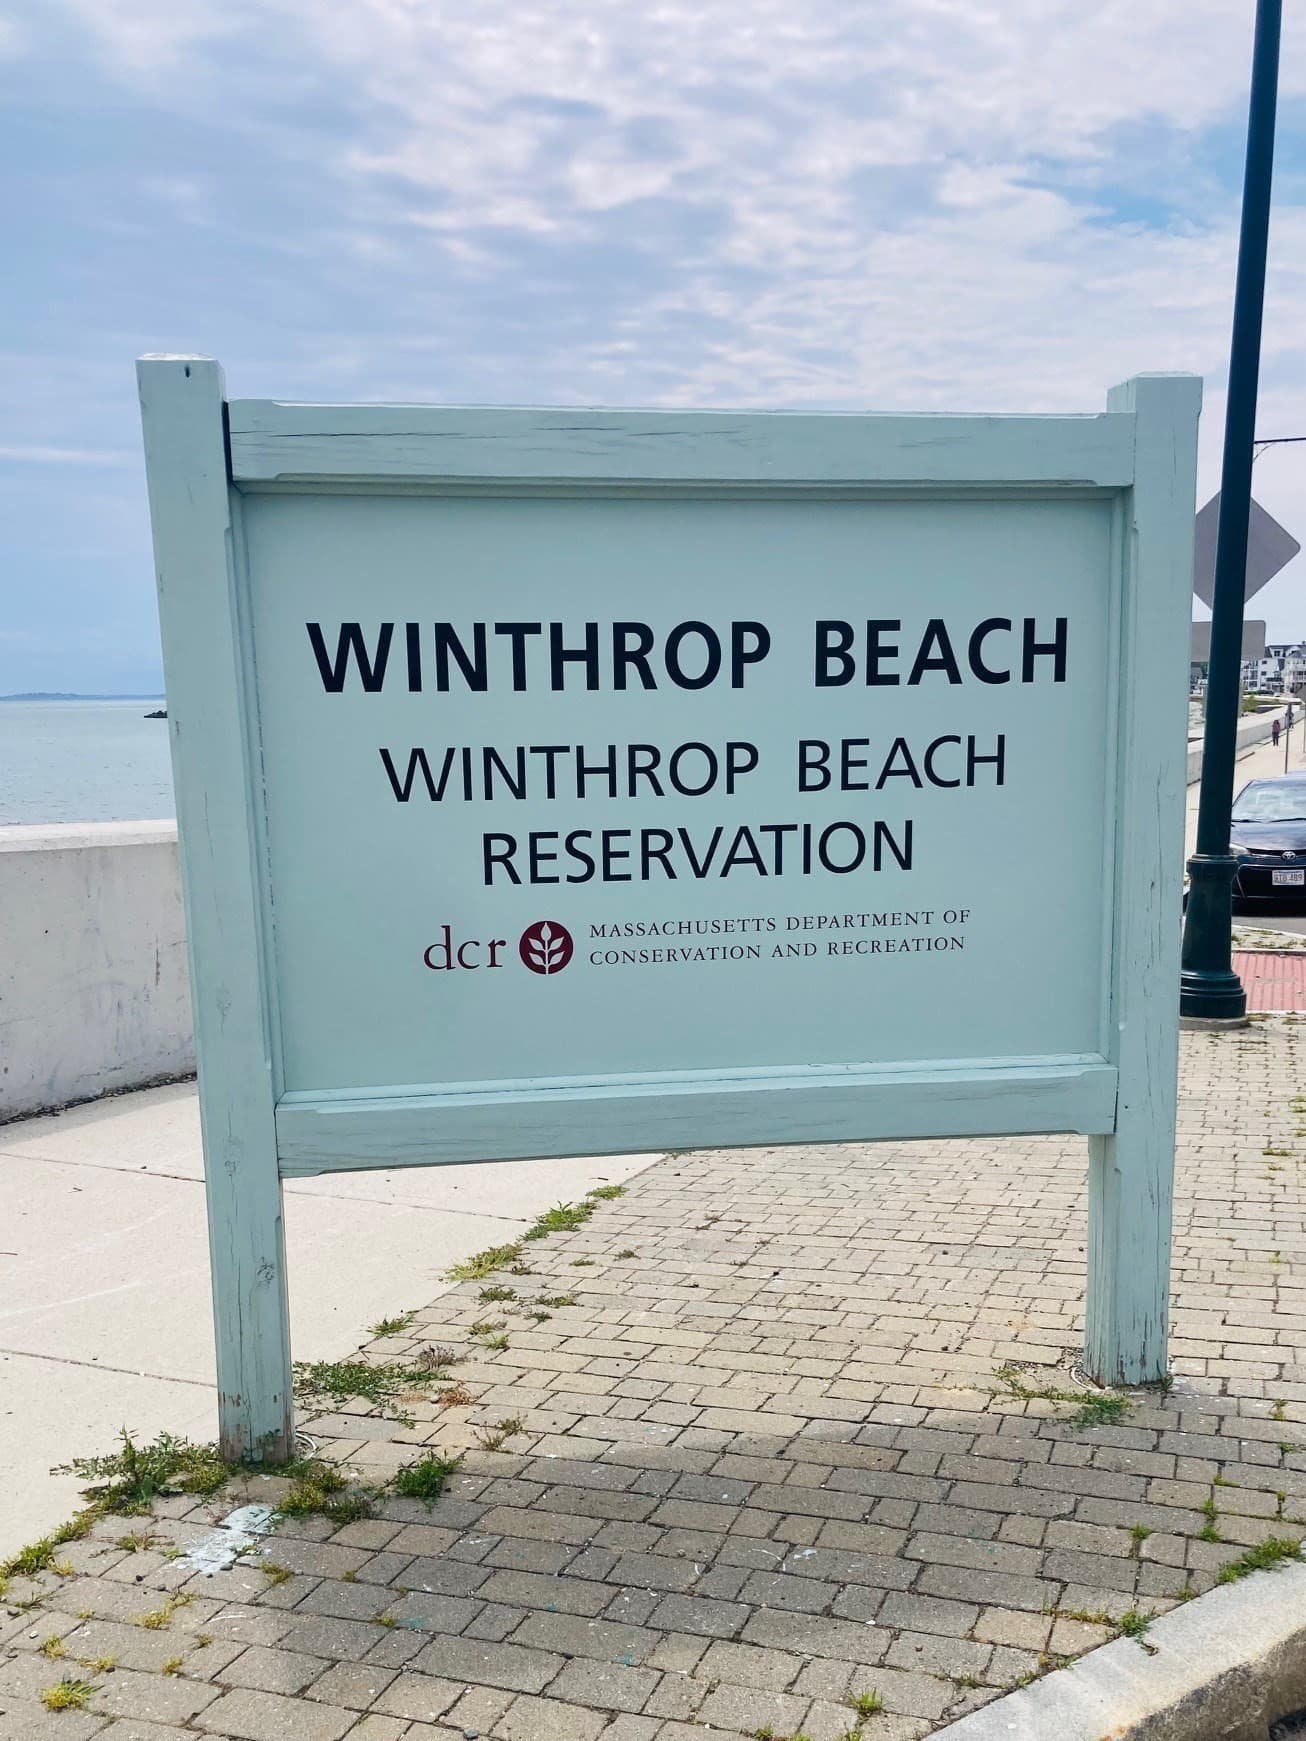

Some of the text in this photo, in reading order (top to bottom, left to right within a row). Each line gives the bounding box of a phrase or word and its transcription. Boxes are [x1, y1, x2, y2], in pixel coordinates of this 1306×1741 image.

[304, 615, 1070, 694] WINTHROP BEACH
[378, 733, 1006, 803] WINTHROP BEACH
[482, 819, 914, 886] RESERVATION
[423, 924, 507, 971] dcr
[588, 909, 972, 939] MASSACHUSETTS DEPARTMENT OF
[589, 935, 966, 966] CONSERVATION AND RECREATION
